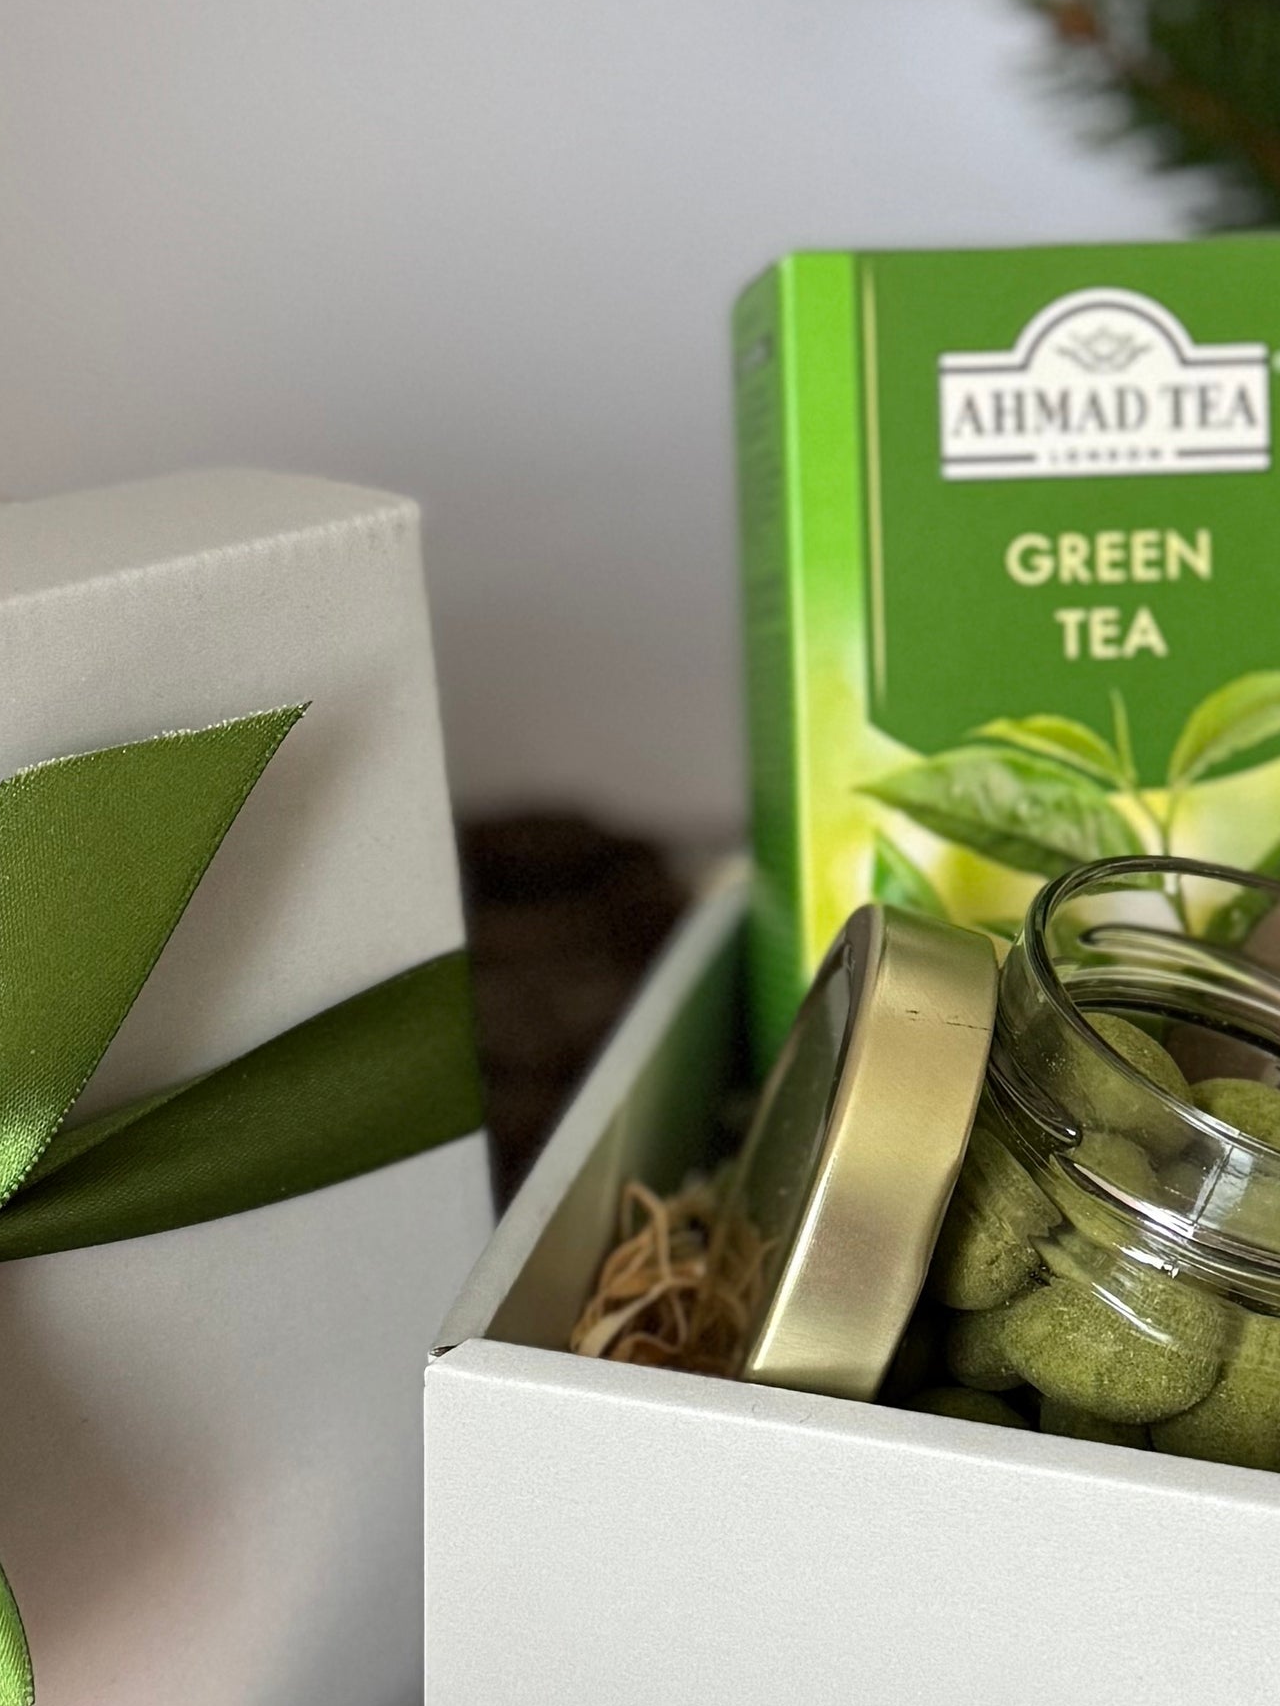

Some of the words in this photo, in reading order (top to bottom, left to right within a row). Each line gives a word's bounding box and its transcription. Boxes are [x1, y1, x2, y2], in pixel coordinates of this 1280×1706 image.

[951, 385, 1150, 439] AHMAD
[1158, 382, 1258, 432] TEA
[1005, 526, 1213, 587] GREEN
[1053, 604, 1170, 661] TEA
